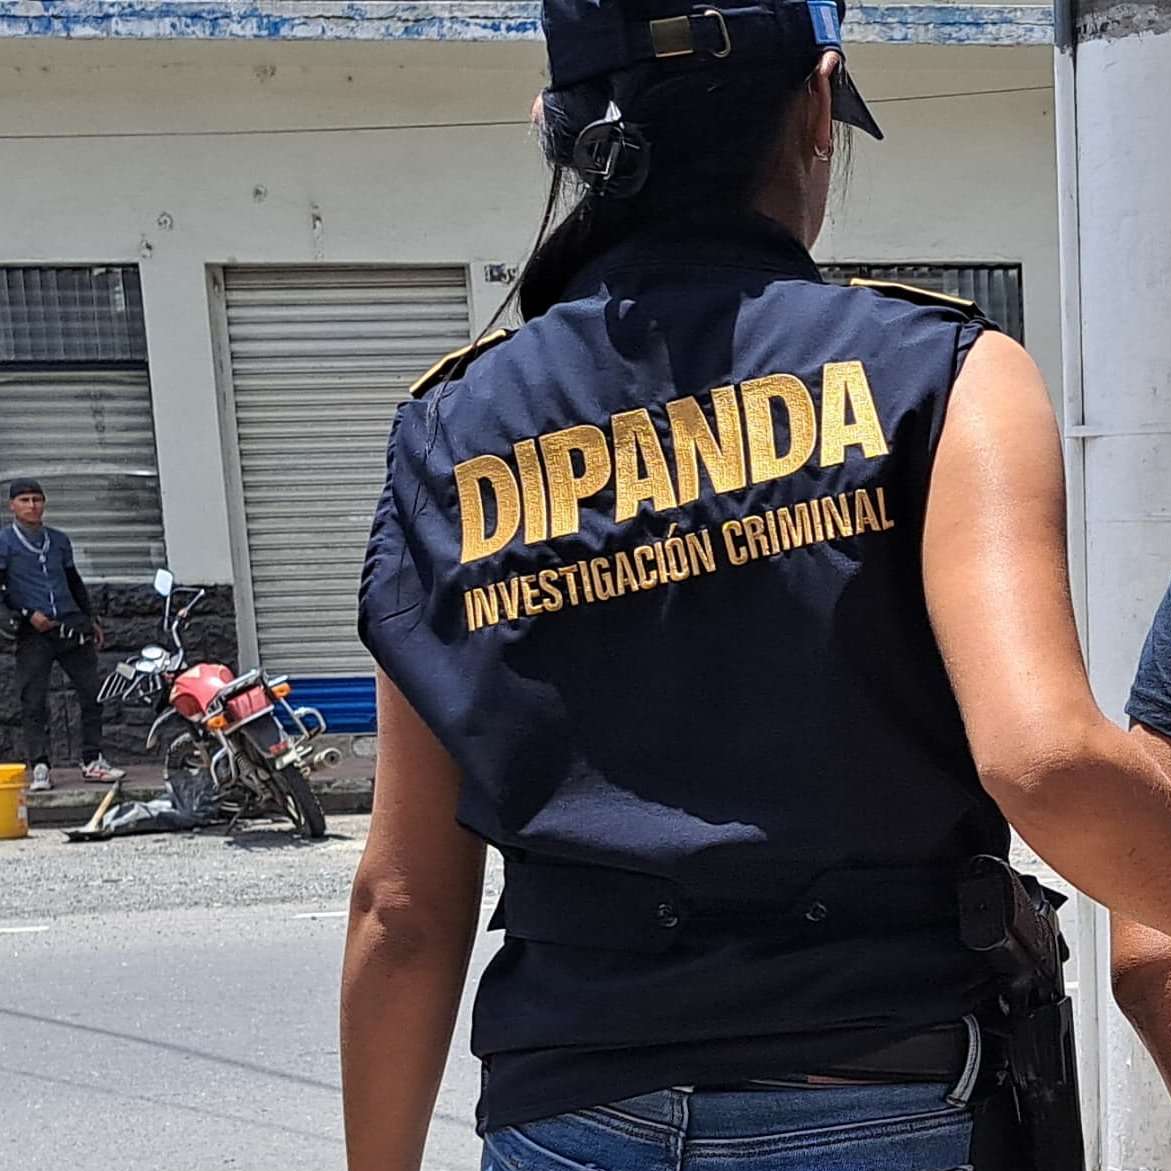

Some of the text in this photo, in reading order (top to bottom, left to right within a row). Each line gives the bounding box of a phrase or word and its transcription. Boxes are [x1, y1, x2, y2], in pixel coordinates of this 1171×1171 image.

[454, 360, 889, 564] DIPANDA
[464, 487, 895, 631] INVESTIGACIÓN CRIMINAL
